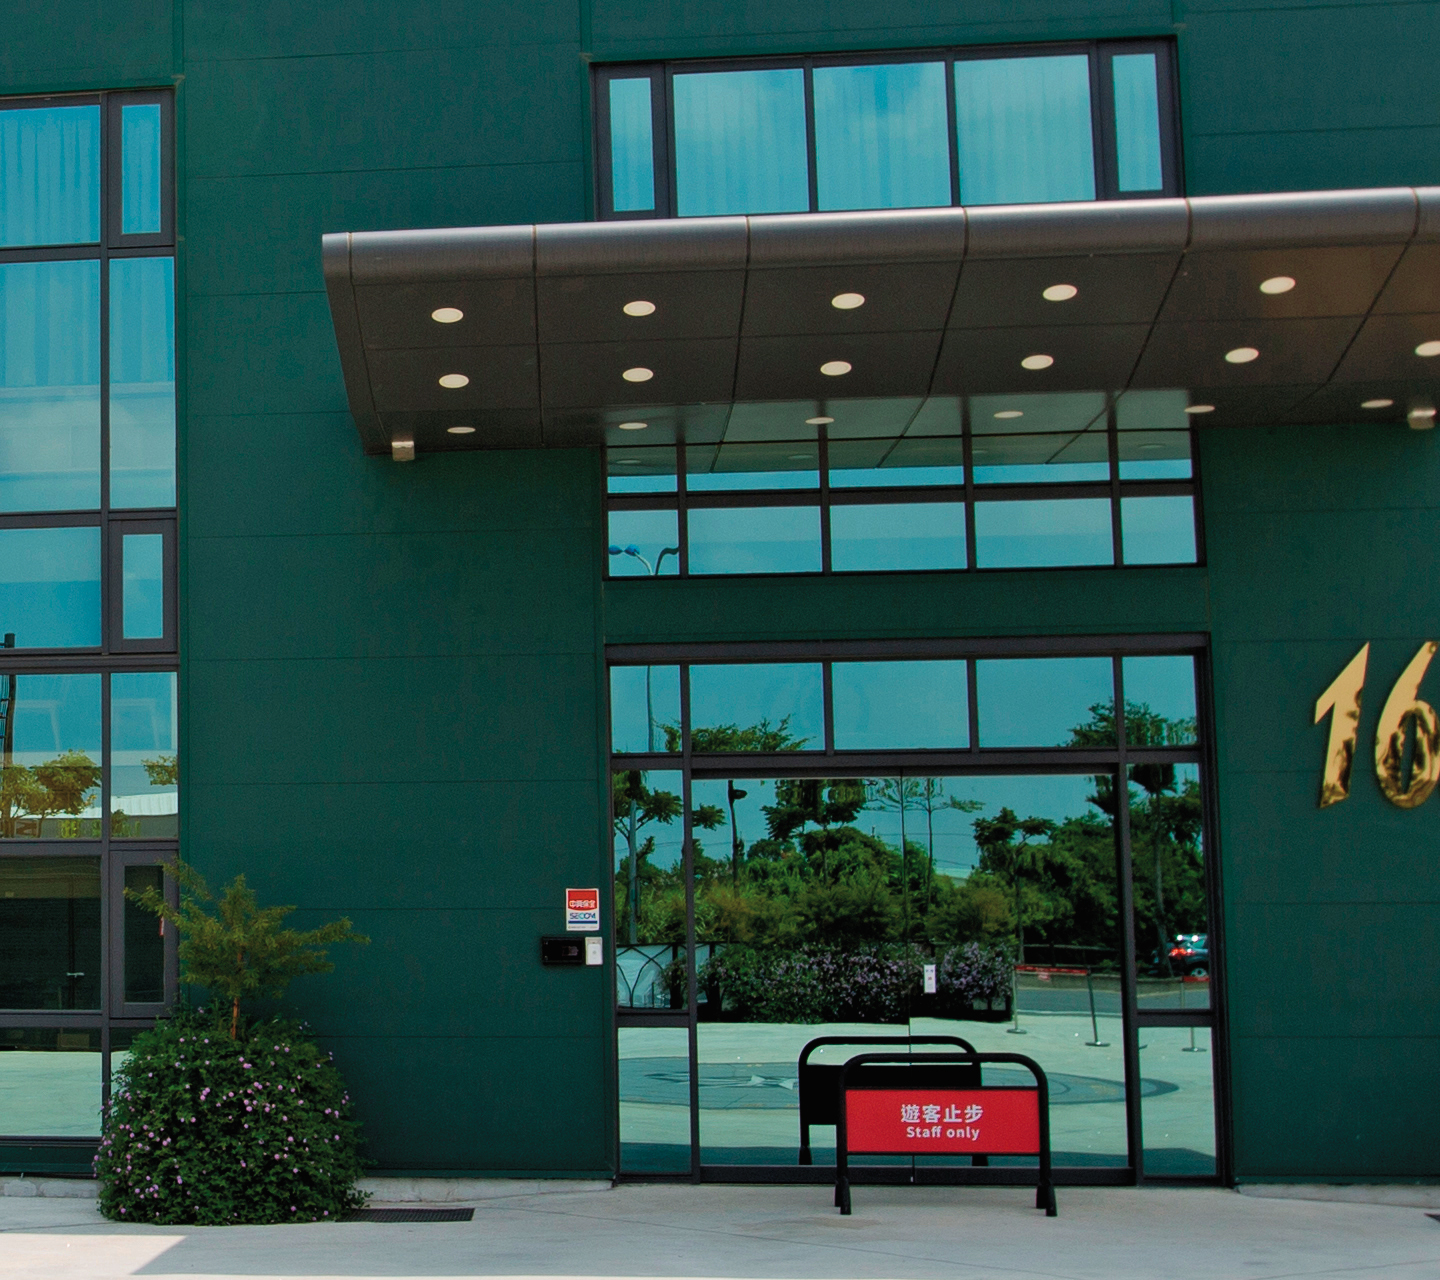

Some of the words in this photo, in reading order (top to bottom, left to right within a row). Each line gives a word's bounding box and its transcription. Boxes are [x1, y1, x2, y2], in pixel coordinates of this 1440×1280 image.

[901, 1104, 984, 1123] 遊客止步
[906, 1125, 942, 1138] Staff
[946, 1125, 980, 1141] only
